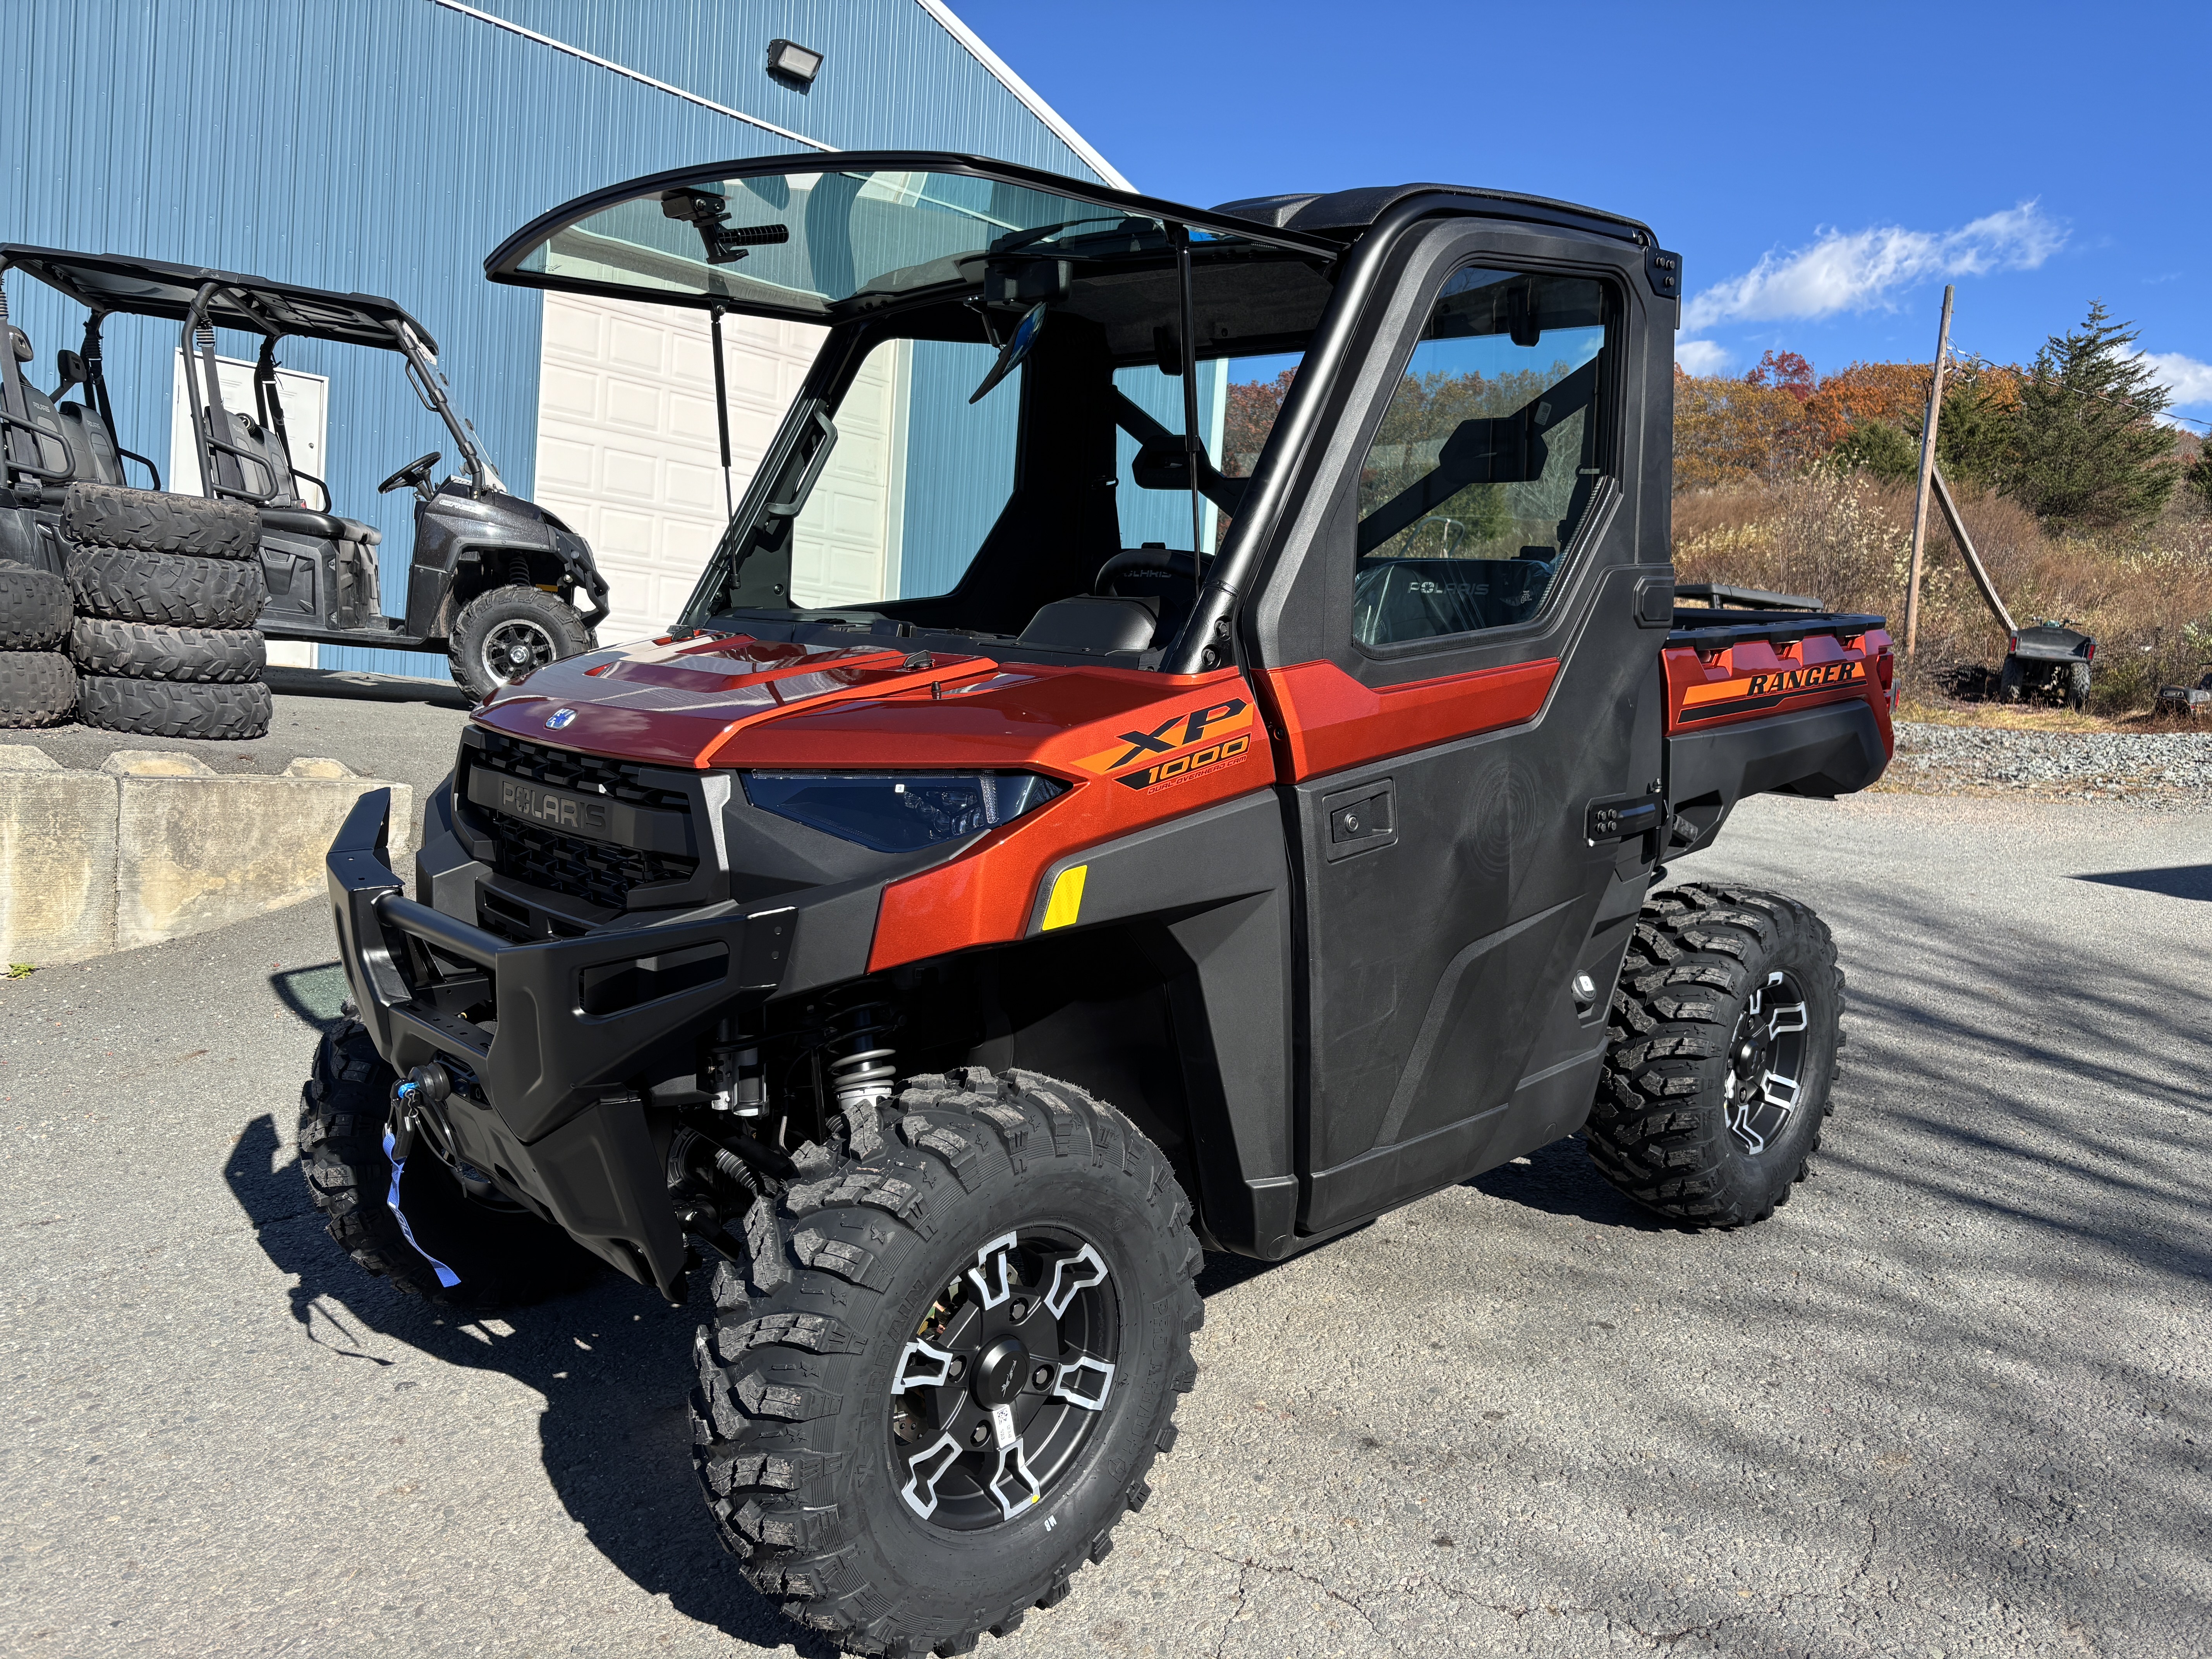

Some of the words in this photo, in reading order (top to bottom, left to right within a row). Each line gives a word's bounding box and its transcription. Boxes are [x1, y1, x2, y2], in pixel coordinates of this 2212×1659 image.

[1407, 582, 1489, 595] POLARIS
[1746, 662, 1855, 696] RANGER
[1105, 698, 1247, 771] XP
[1149, 735, 1249, 784] 1000
[1149, 781, 1175, 793] DUAL
[1176, 763, 1225, 784] OVERHEAD
[1227, 756, 1246, 766] CAM
[503, 781, 606, 833] POLARIS
